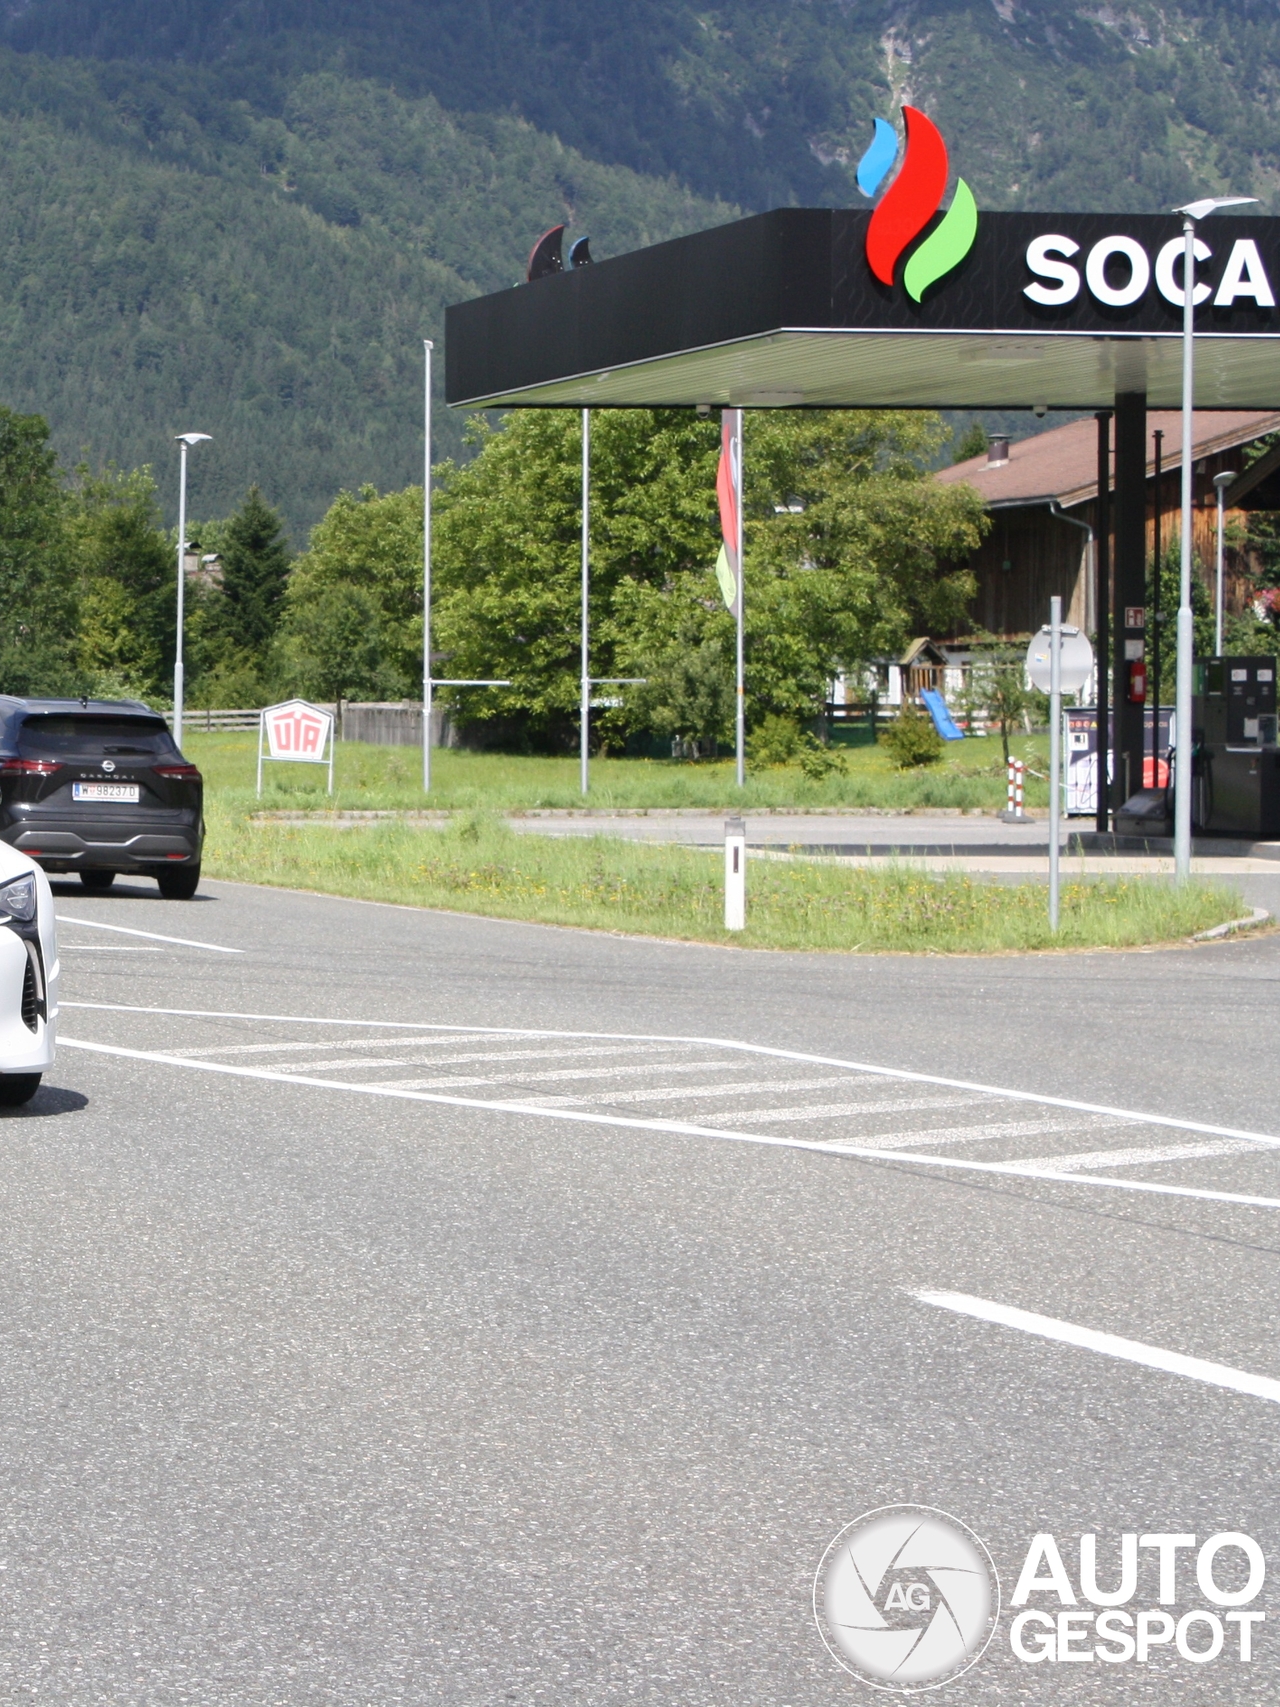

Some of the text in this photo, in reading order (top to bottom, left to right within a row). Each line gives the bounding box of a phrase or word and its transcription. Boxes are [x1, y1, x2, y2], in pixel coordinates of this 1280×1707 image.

[1023, 233, 1276, 308] SOCA
[273, 711, 322, 752] UTA
[82, 785, 89, 795] W
